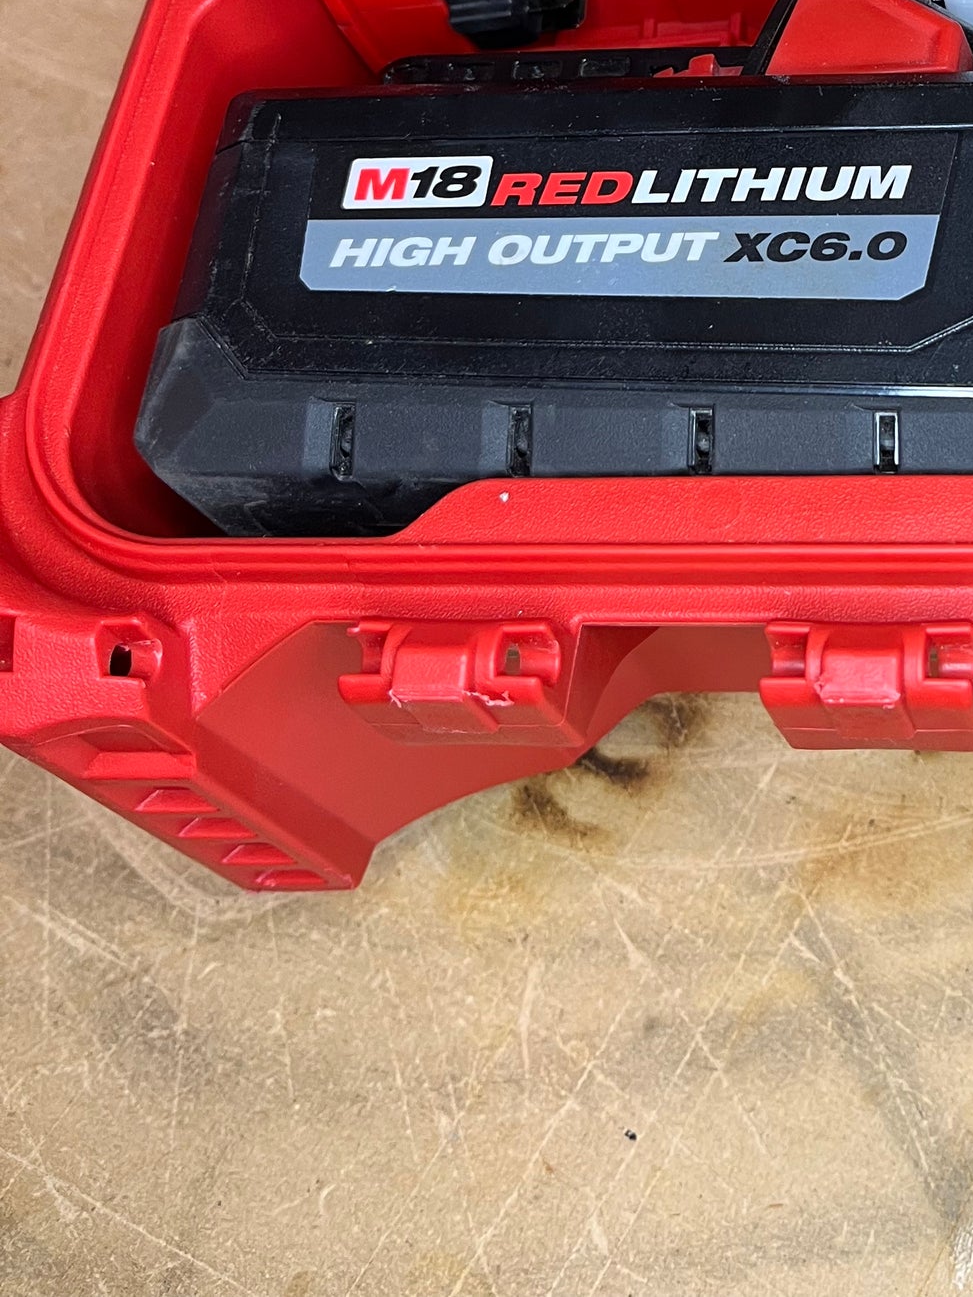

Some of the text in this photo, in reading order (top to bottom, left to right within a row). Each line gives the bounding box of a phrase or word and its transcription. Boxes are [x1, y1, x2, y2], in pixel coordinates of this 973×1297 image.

[353, 165, 913, 207] M18 REDLITHIUM
[329, 231, 908, 268] HIGH OUTPUT XC6.0
